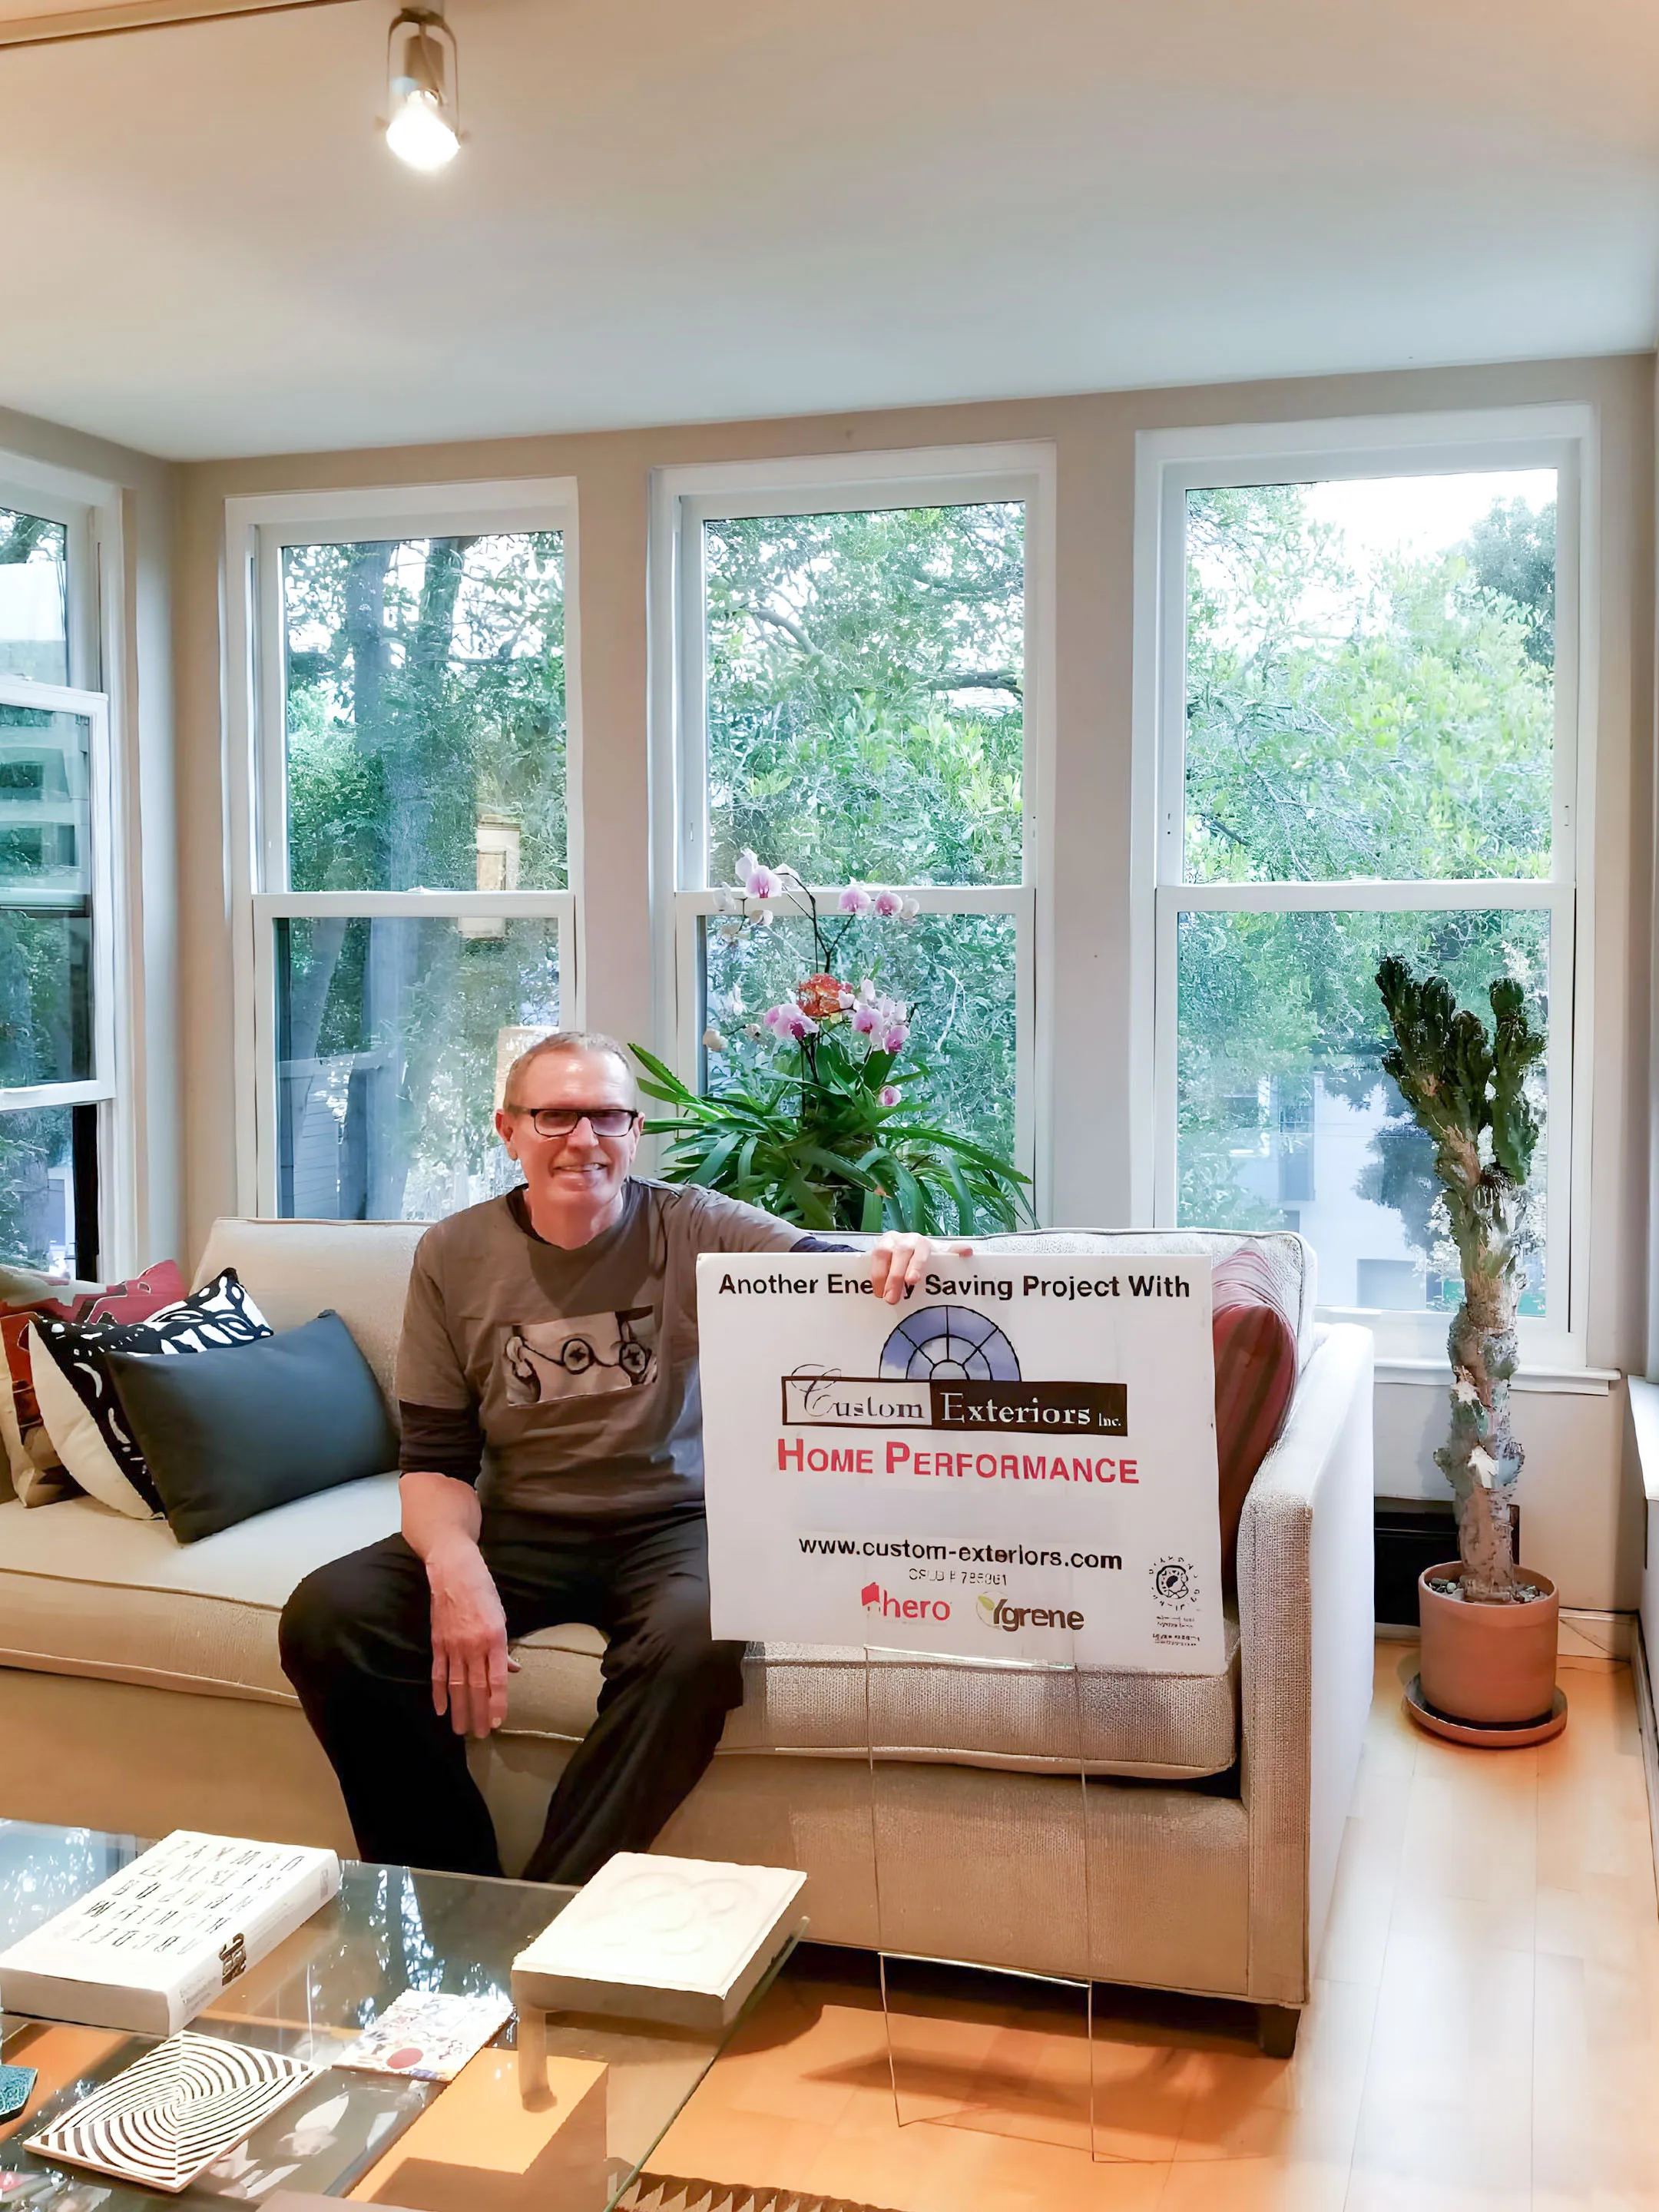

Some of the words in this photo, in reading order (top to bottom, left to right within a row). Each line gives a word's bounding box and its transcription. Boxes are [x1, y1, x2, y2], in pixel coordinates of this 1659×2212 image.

[719, 1273, 818, 1295] Another
[827, 1273, 916, 1300] Eney
[925, 1273, 1012, 1300] Saving
[1023, 1275, 1120, 1300] Project
[1128, 1275, 1190, 1297] With
[939, 1392, 1091, 1425] Exteriors
[1098, 1412, 1121, 1427] Inc.
[777, 1438, 874, 1474] HOME
[886, 1441, 1140, 1485] PERFORMANCE
[798, 1537, 1123, 1570] www.custom-exteriors.com
[883, 1590, 951, 1621] hero
